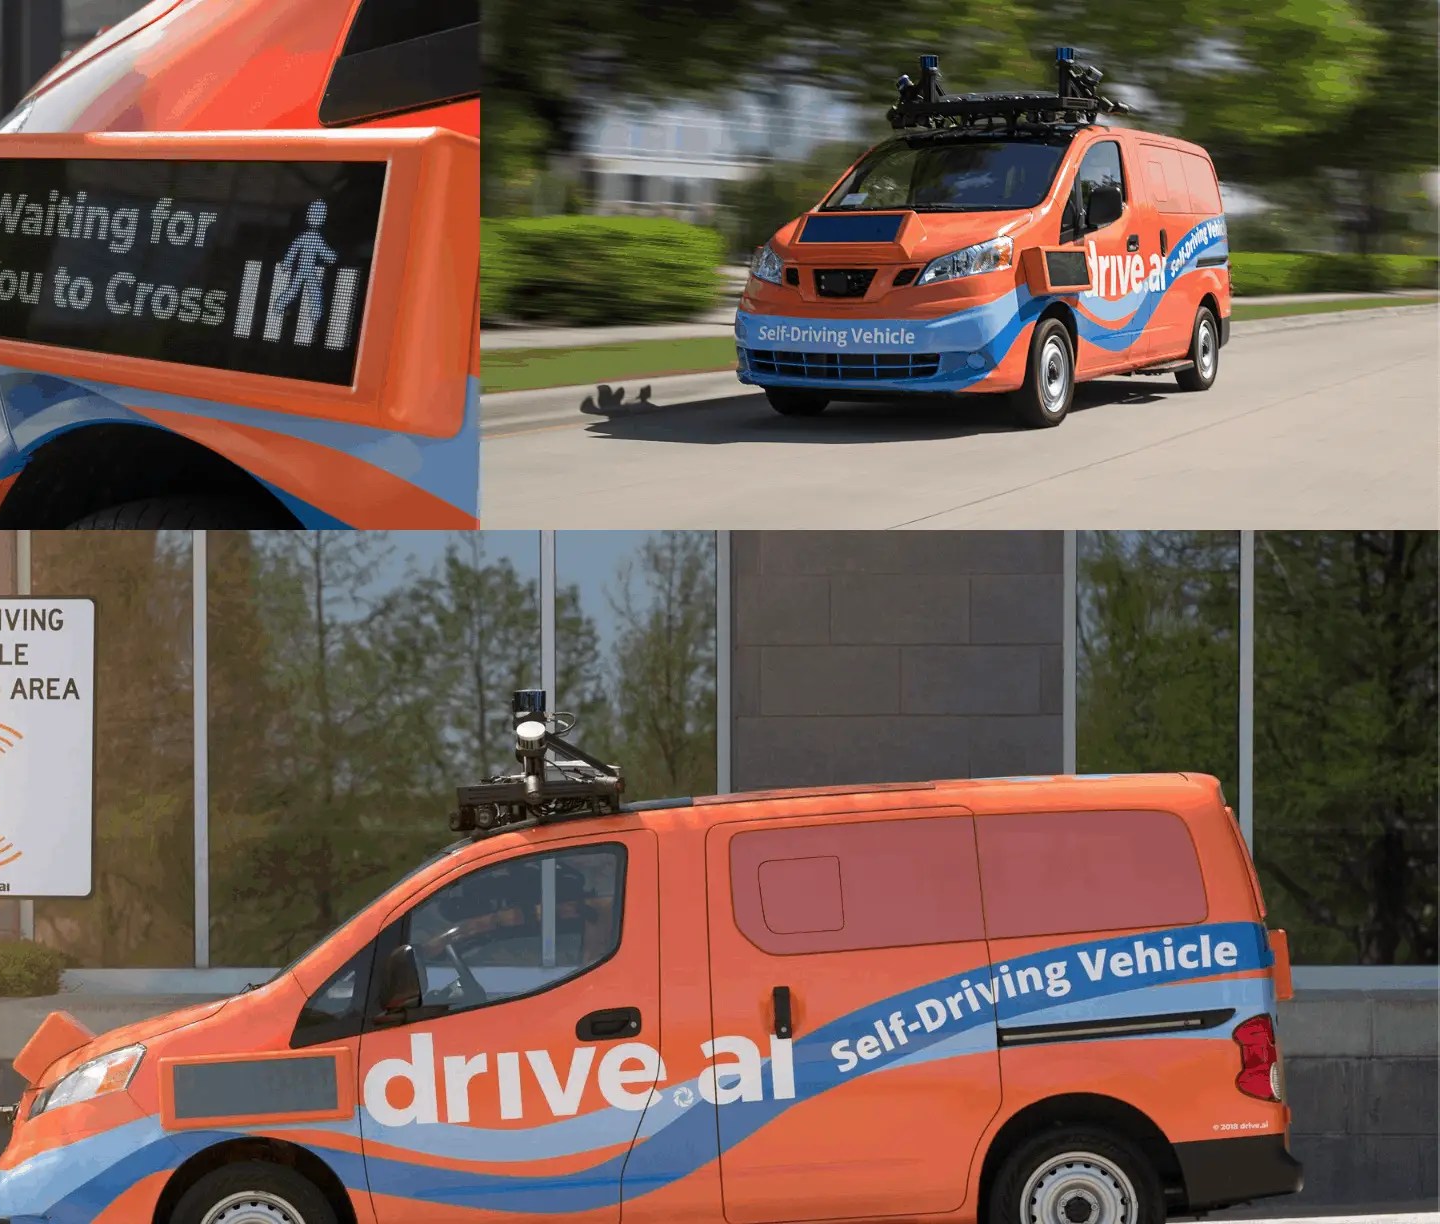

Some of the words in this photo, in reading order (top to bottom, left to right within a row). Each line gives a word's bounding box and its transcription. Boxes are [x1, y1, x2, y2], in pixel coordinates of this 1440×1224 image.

[150, 197, 218, 248] for
[53, 267, 94, 310] to
[105, 271, 229, 326] Cross
[758, 325, 848, 347] Self-Driving
[851, 327, 916, 345] Vehicle
[10, 677, 81, 700] AREA
[831, 959, 1070, 1073] Self-Driving
[1077, 934, 1239, 983] Vehicle
[363, 1032, 796, 1128] drive.ai
